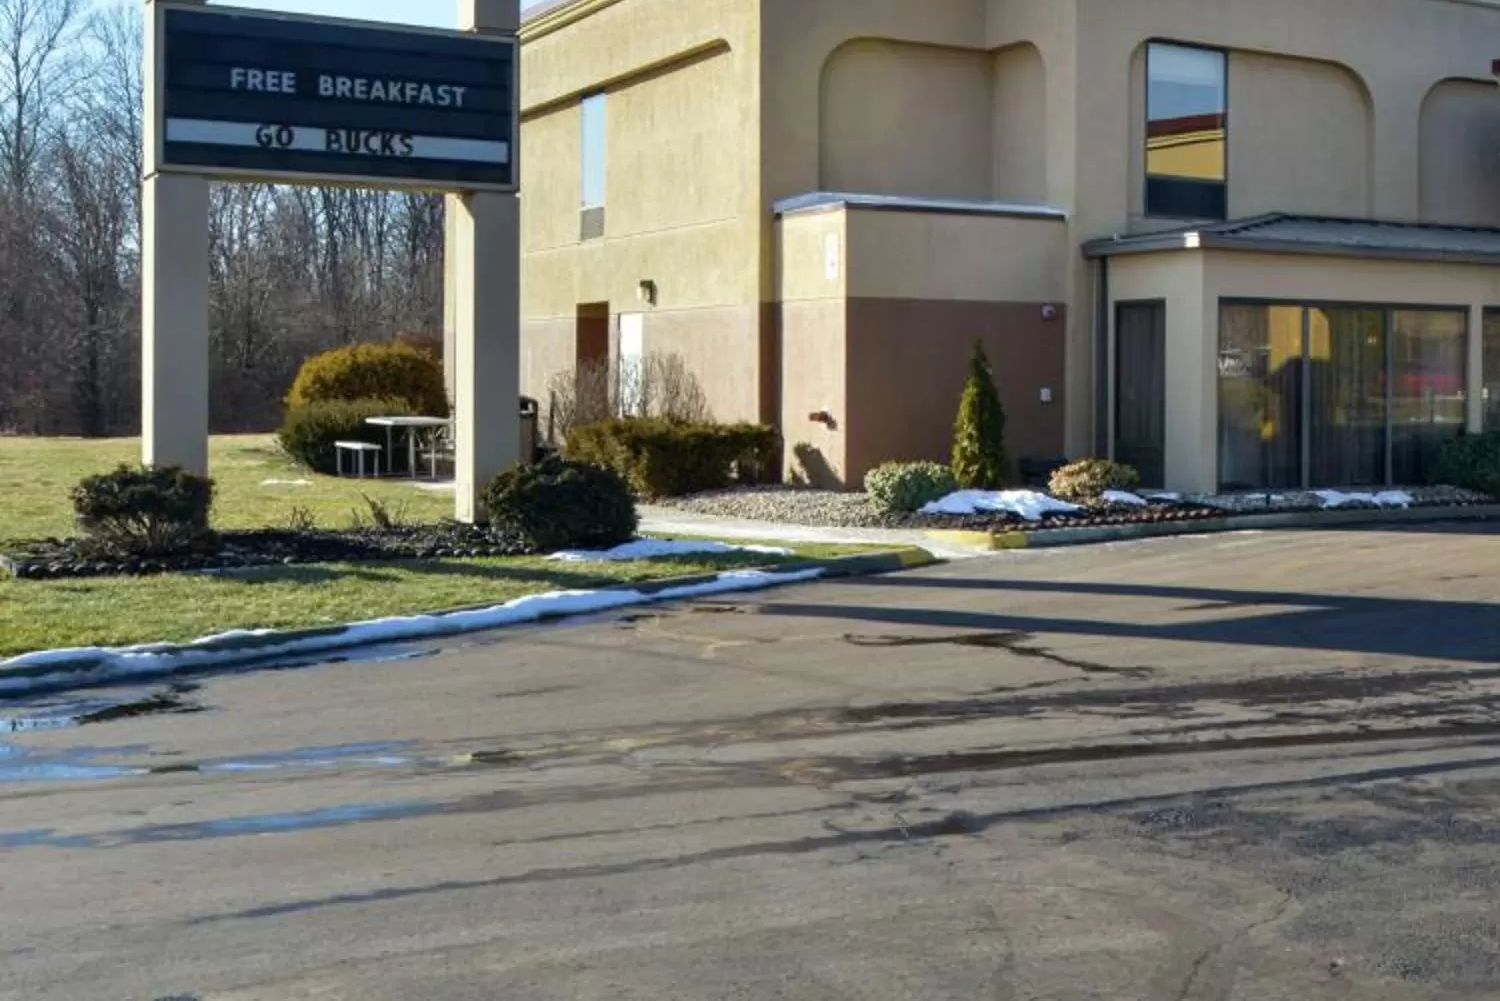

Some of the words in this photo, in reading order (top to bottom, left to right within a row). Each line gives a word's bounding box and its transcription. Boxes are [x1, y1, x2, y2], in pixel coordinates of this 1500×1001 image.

[230, 67, 297, 94] FREE
[318, 74, 467, 107] BREAKFAST
[255, 124, 295, 148] GO
[325, 128, 415, 157] BUCKS
